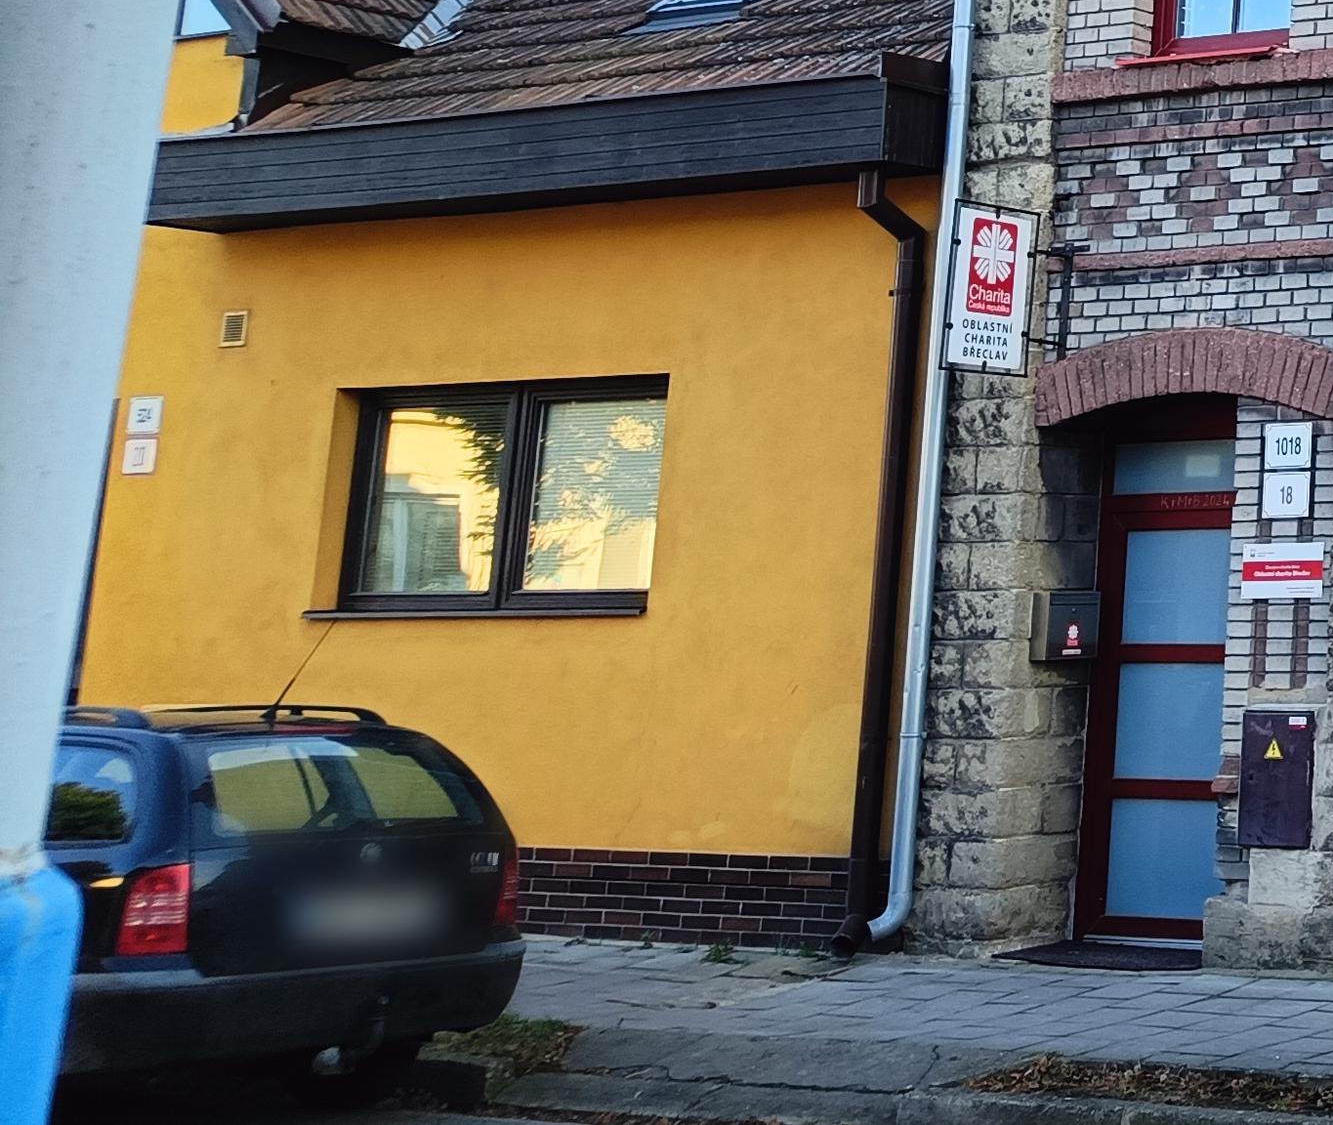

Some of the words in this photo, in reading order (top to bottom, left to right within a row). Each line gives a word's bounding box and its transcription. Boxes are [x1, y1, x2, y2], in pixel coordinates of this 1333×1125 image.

[969, 284, 1010, 304] Charita
[962, 319, 1012, 333] OBLASTNÍ
[965, 333, 1007, 347] CHARITA
[963, 346, 1007, 360] BŘECLAV
[1275, 436, 1302, 456] 1018
[1280, 486, 1293, 504] 18
